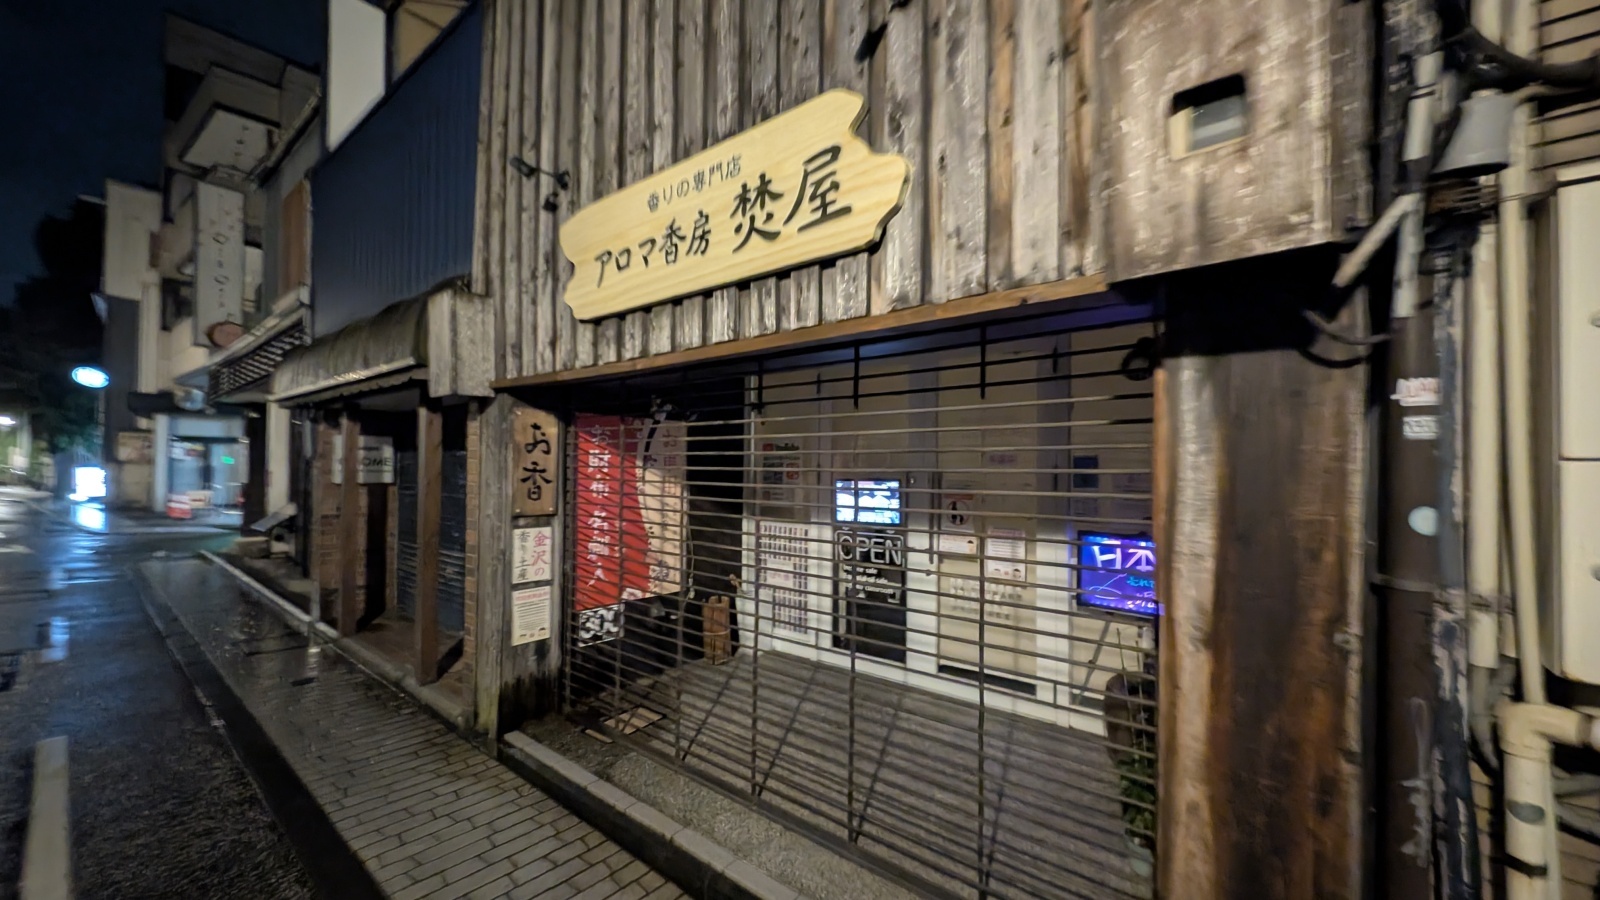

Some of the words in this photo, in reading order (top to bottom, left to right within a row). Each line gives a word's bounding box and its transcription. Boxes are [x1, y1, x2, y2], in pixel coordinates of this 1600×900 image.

[647, 152, 742, 213] 香りの専門店
[594, 210, 713, 289] アロマ香房
[730, 145, 853, 254] 焚屋
[520, 422, 553, 502] お香
[531, 530, 551, 577] 金沢の
[838, 535, 902, 565] OPEN
